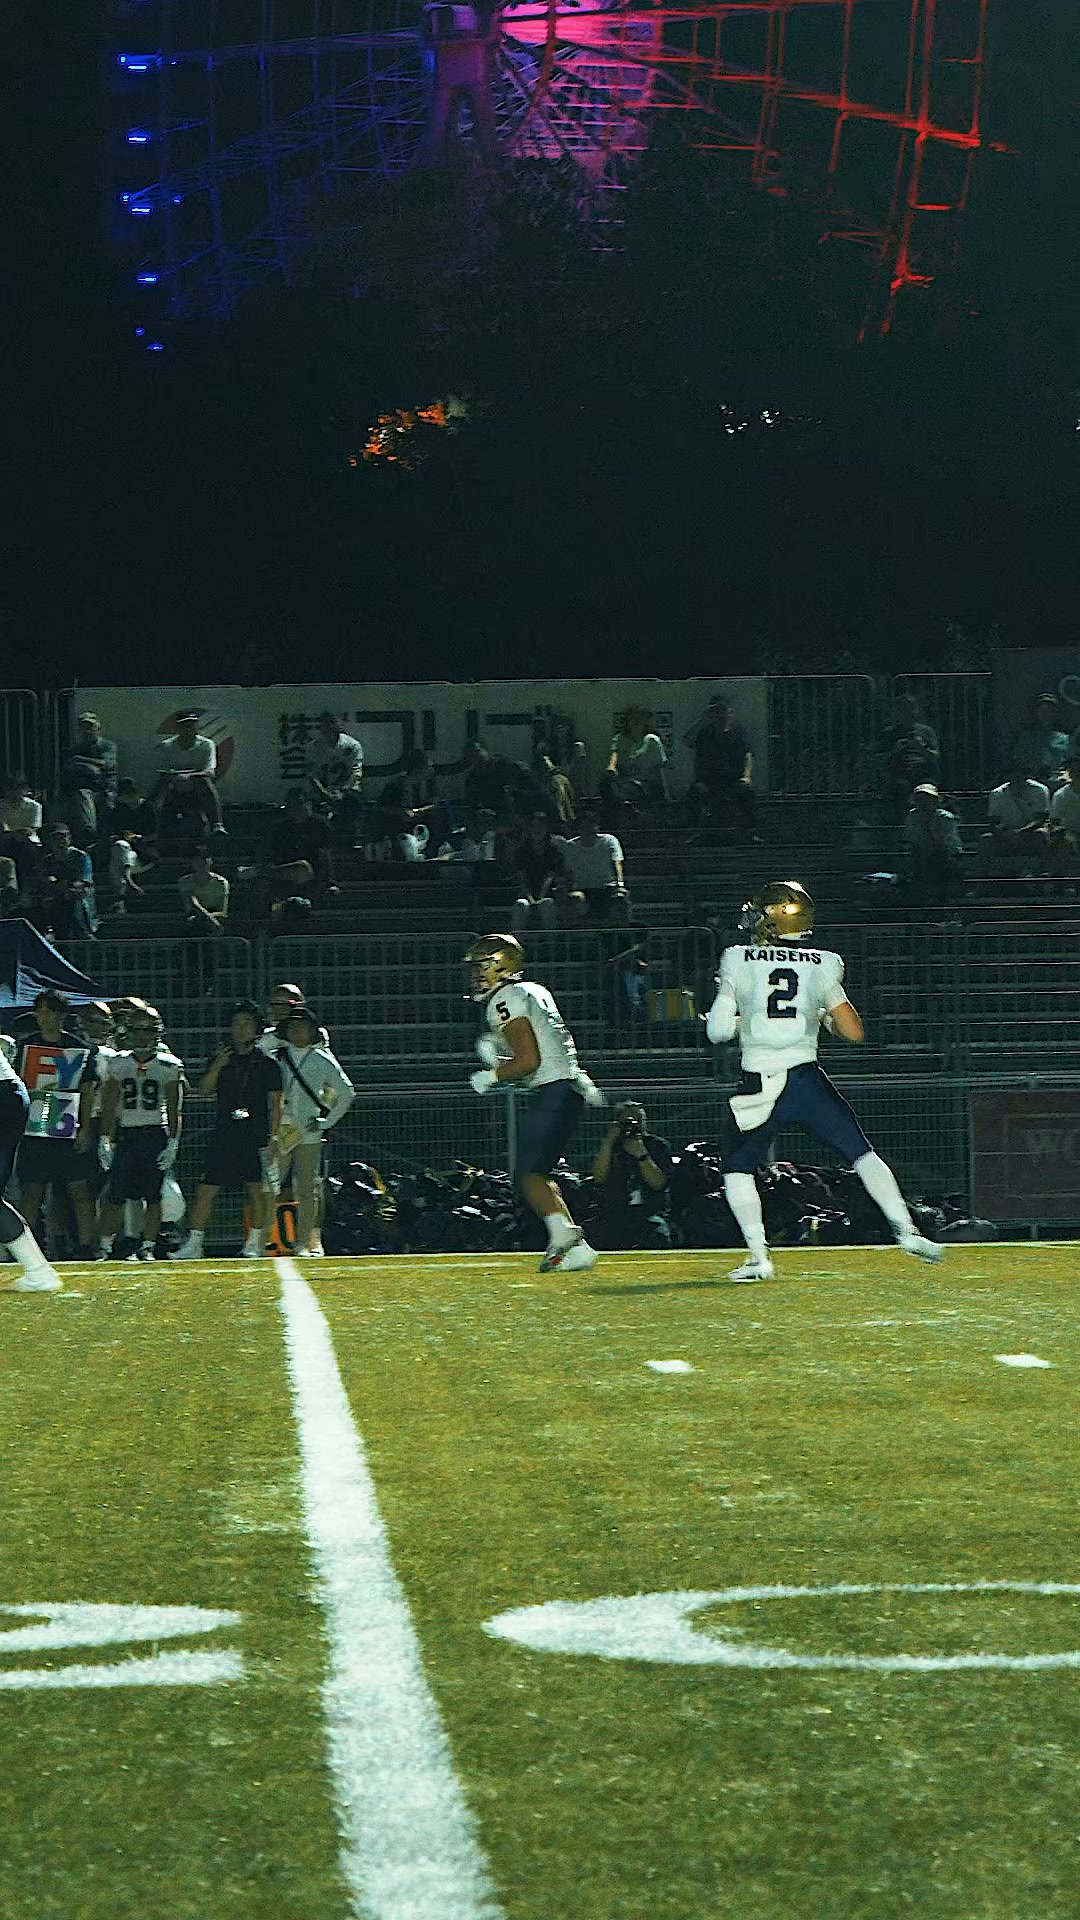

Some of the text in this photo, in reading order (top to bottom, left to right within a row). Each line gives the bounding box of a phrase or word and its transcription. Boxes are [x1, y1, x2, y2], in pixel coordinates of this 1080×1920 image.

[744, 949, 822, 965] KAISERS
[767, 968, 799, 1019] 2
[495, 1001, 511, 1022] 5
[121, 1077, 159, 1111] 29
